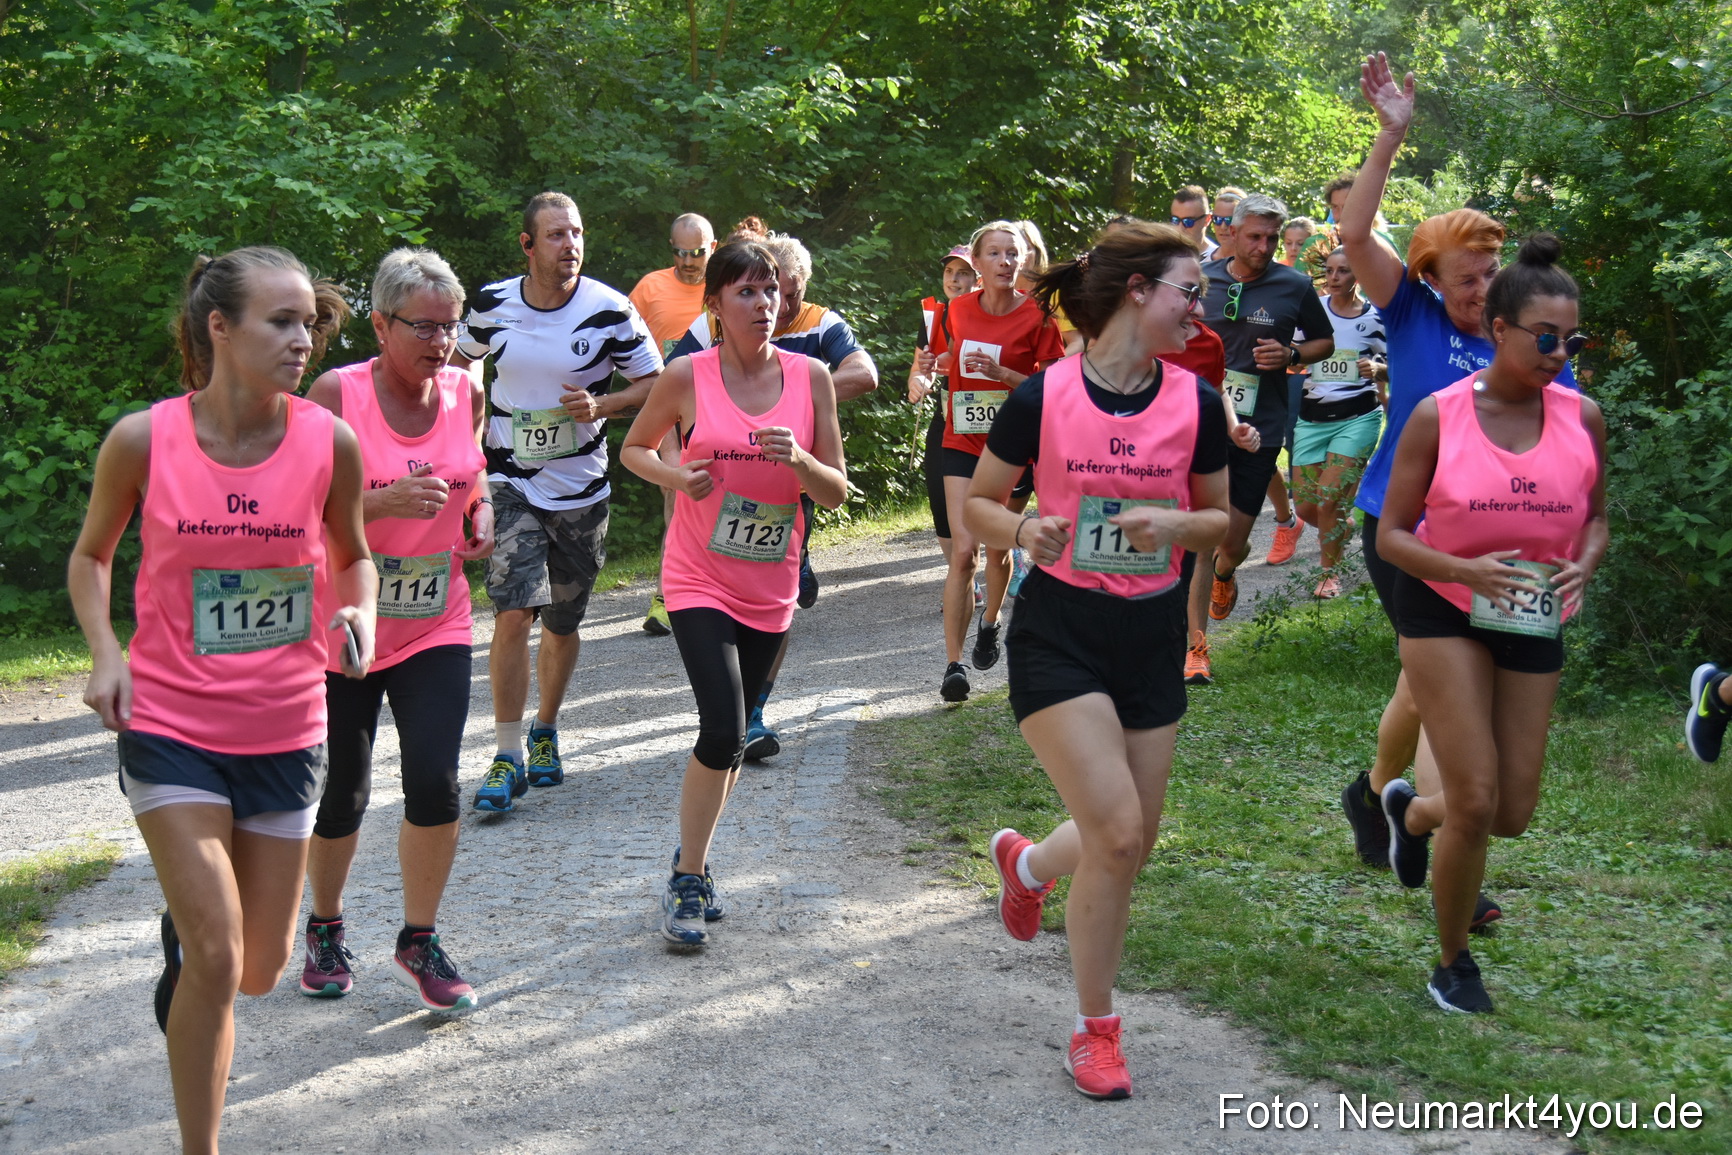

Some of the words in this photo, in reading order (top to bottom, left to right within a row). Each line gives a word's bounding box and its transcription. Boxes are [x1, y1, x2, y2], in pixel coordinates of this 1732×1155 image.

[1321, 361, 1348, 374] 800
[965, 406, 997, 422] 530
[522, 425, 560, 447] 797
[1110, 437, 1136, 457] Die
[1066, 459, 1173, 481] Kieferorthopäden
[1510, 477, 1537, 495] Die
[227, 493, 260, 515] Die
[1469, 498, 1574, 517] Kieferorthopäden
[177, 519, 306, 543] Kieferorthopäden
[727, 518, 785, 547] 1123
[725, 539, 753, 551] Schmidt
[752, 545, 777, 553] Susanne
[1089, 551, 1131, 561] Schneidler
[209, 595, 294, 631] 1121
[377, 600, 403, 608] rendel
[403, 601, 433, 609] Gerlinde
[1526, 616, 1542, 624] Lisa
[220, 630, 258, 640] Kemena
[259, 626, 289, 637] Louisa
